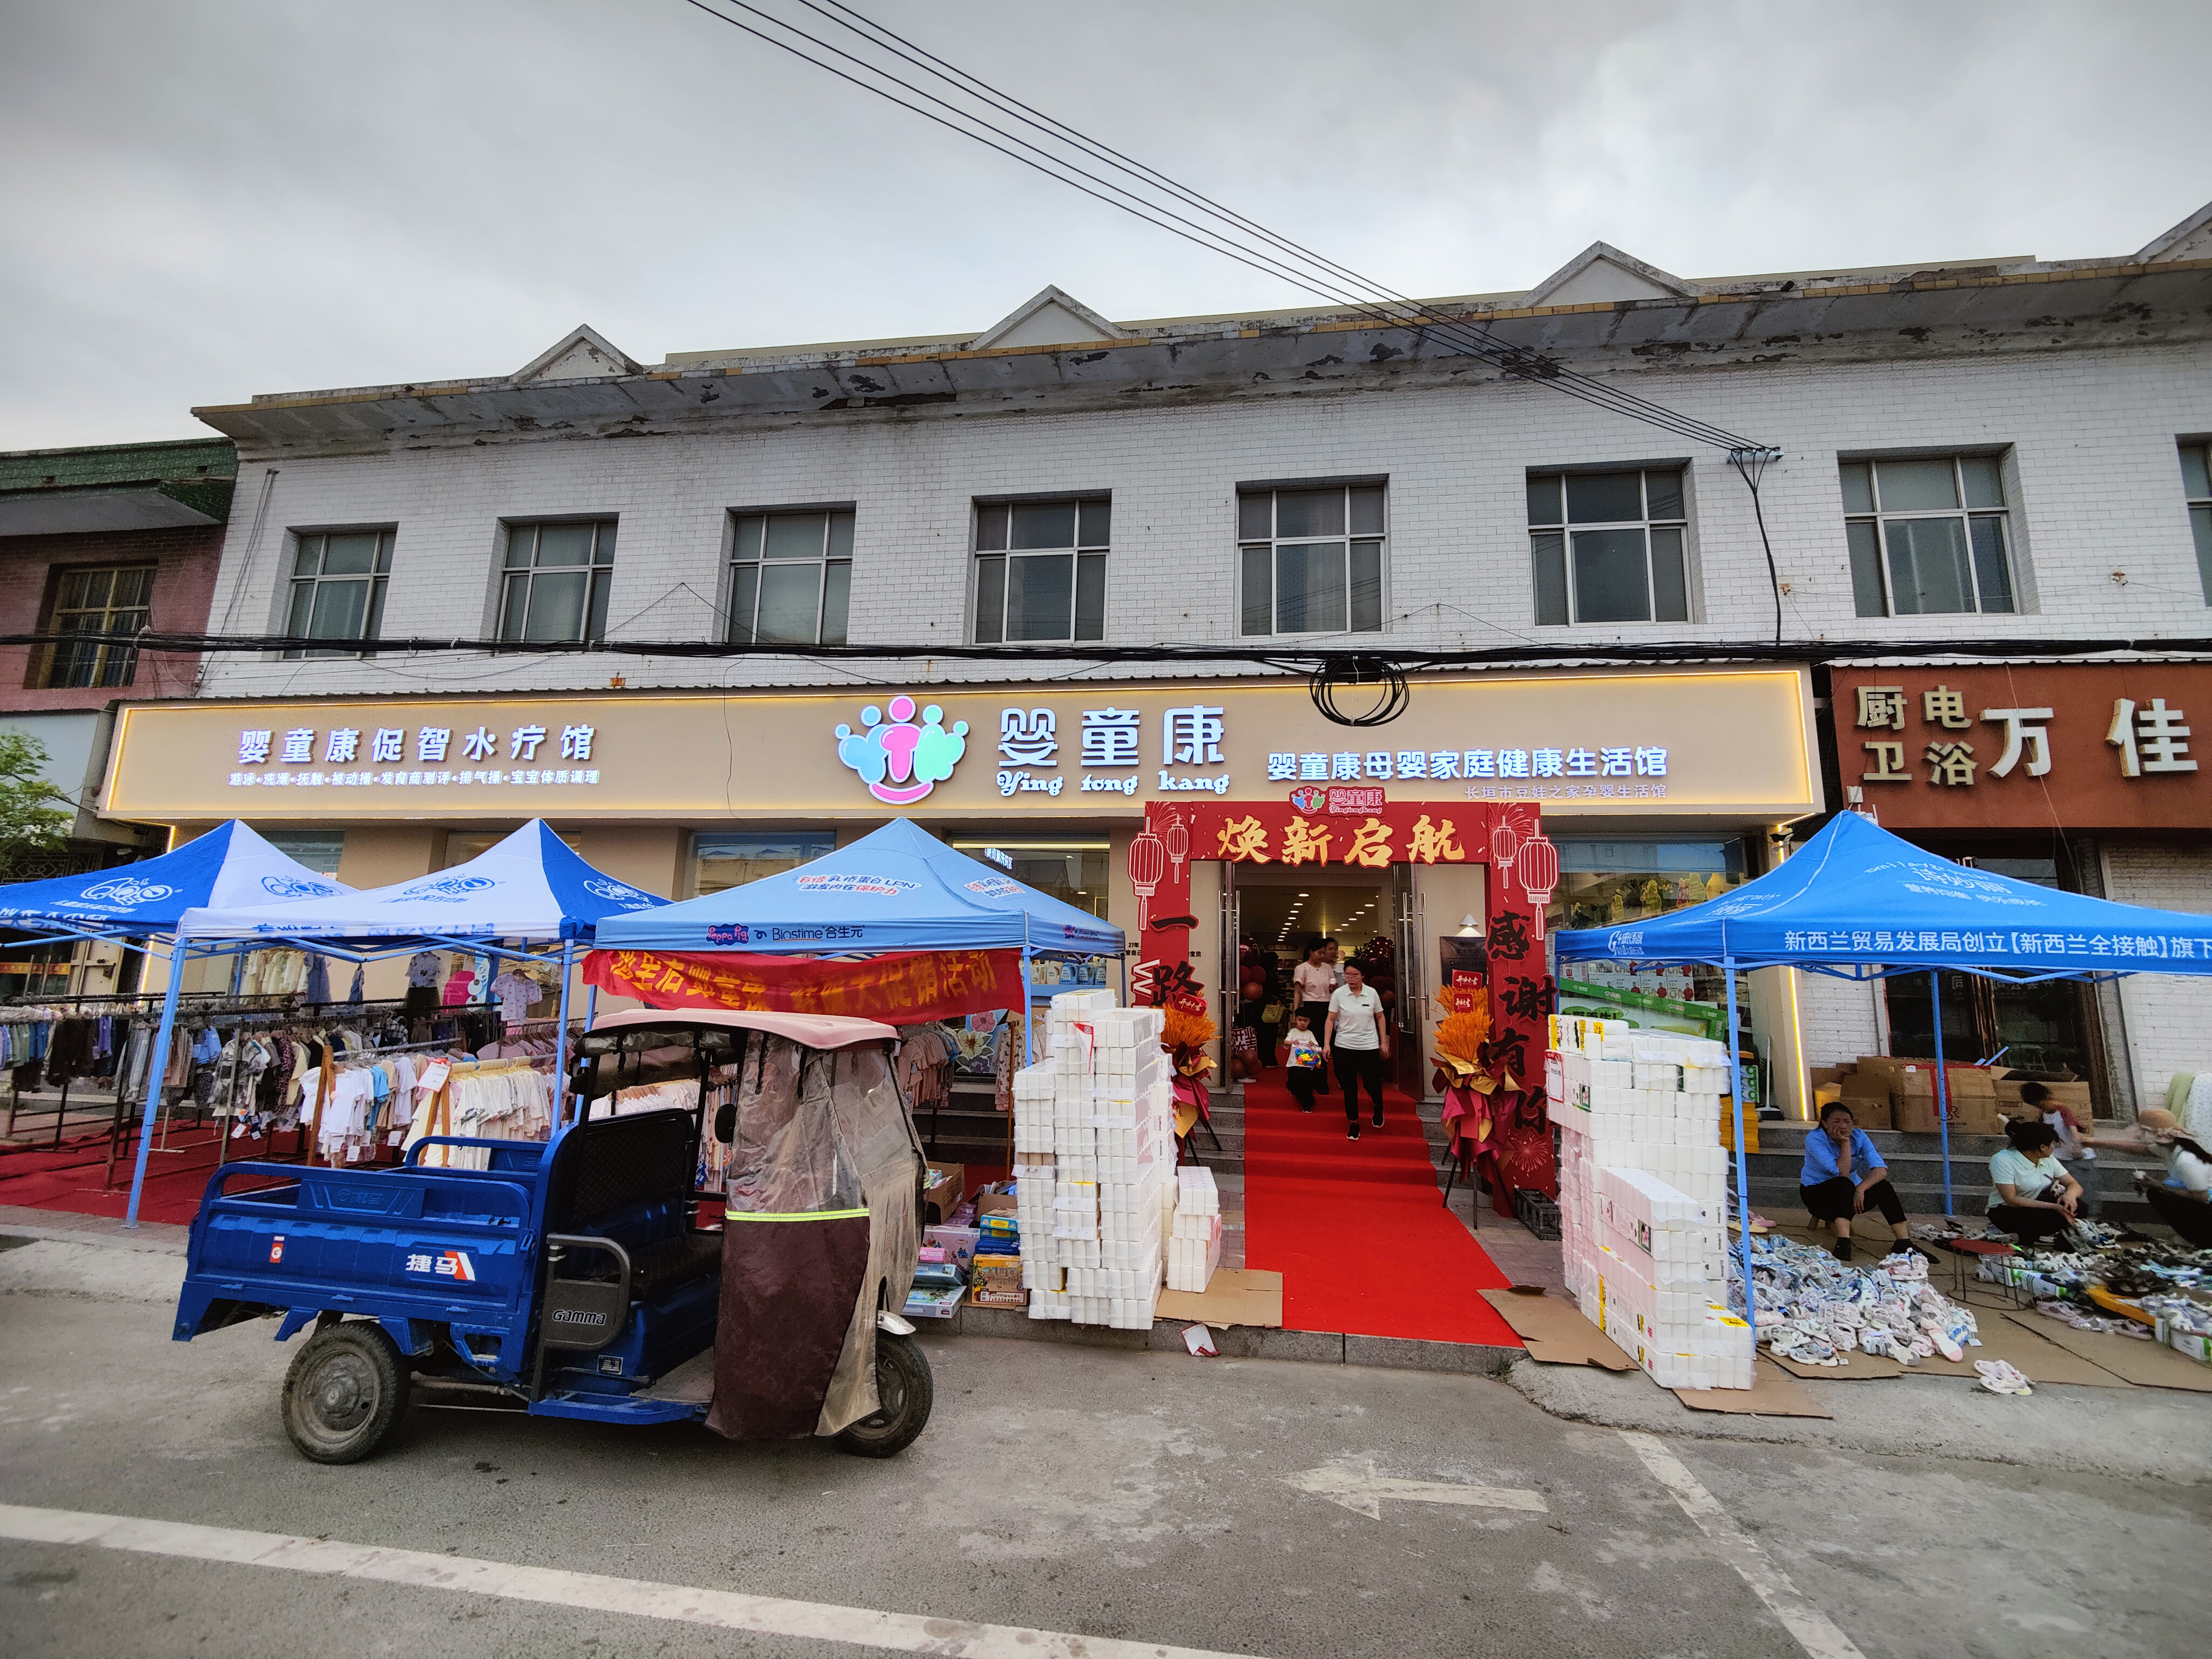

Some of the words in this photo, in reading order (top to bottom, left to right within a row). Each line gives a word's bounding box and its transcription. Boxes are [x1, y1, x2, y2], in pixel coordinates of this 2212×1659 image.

[1856, 685, 1973, 730] 厨电
[238, 724, 596, 764] 婴童康促智水疗馆
[997, 704, 1225, 767] 婴童康
[1980, 698, 2198, 778] 万佳
[1267, 746, 1668, 781] 婴童康母婴家庭健康生活馆
[1862, 740, 1979, 786] 卫浴
[997, 770, 1063, 797] Ying
[1158, 770, 1230, 795] kang
[1465, 784, 1667, 800] 长垣市豆娃之家孕婴生活馆
[1330, 789, 1382, 806] 婴童康
[1217, 814, 1466, 868] 焕新启航
[709, 926, 733, 943] Peppa
[734, 926, 749, 941] Pig
[773, 927, 822, 941] Biostime
[825, 926, 863, 939] 合生元
[1231, 1026, 1255, 1042] 开业
[1488, 910, 1559, 1134] 感谢有你
[1235, 1036, 1257, 1055] 大吉
[404, 1253, 458, 1275] 捷马
[552, 1309, 607, 1327] Gamma
